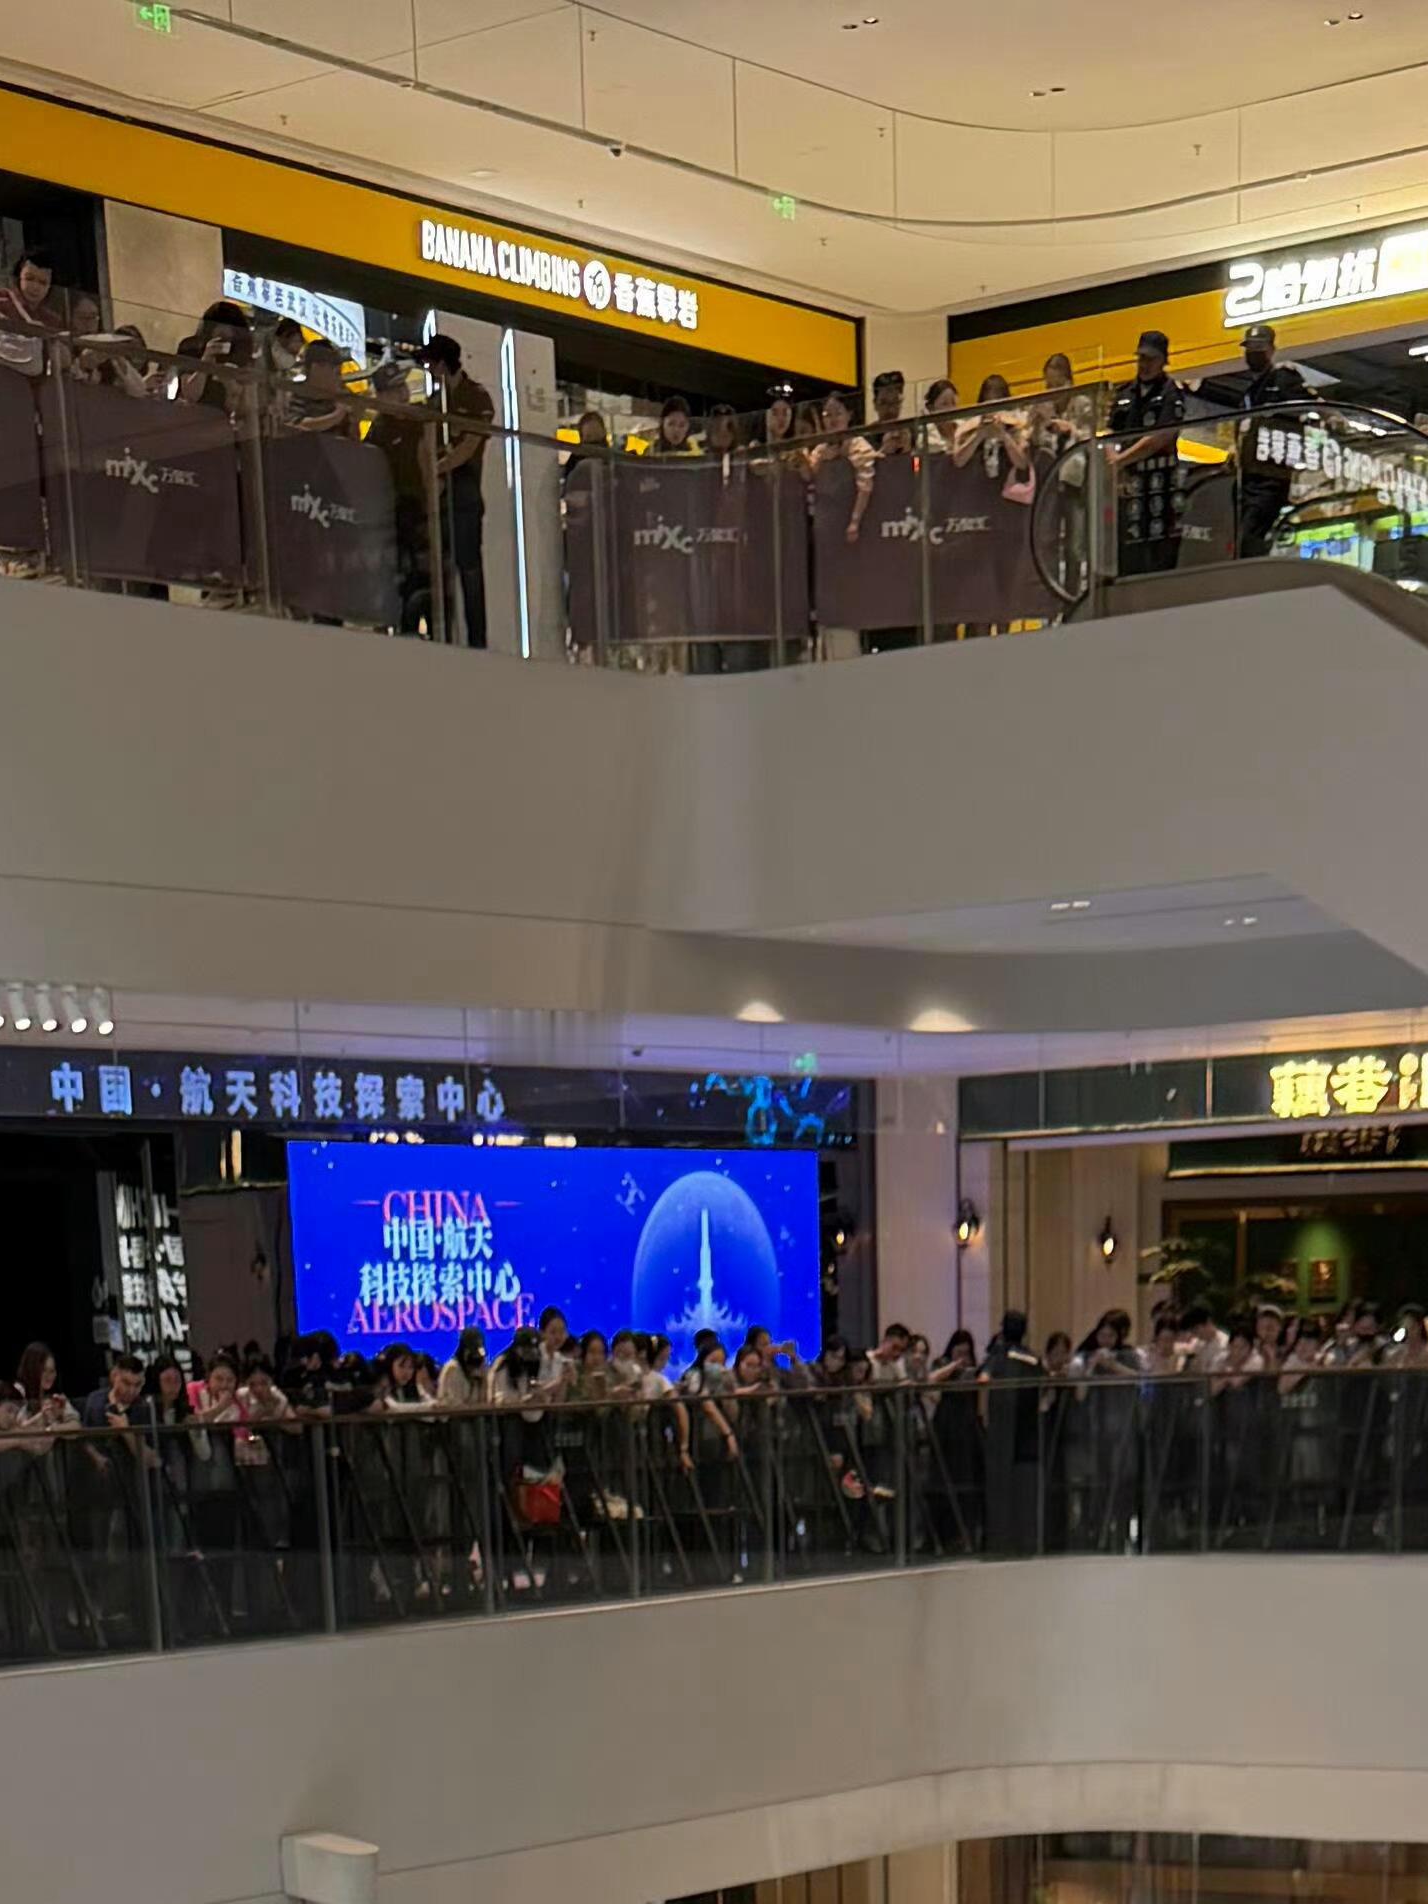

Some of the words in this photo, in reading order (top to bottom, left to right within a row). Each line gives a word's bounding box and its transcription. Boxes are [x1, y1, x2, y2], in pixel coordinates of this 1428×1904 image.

[422, 220, 497, 277] BANANA
[497, 241, 581, 298] CLIMBING
[614, 271, 699, 329] 香蕉攀岩
[383, 1190, 492, 1229] CHINA
[359, 1260, 521, 1307] 科技探索中心
[347, 1293, 535, 1334] AEROSPACE
